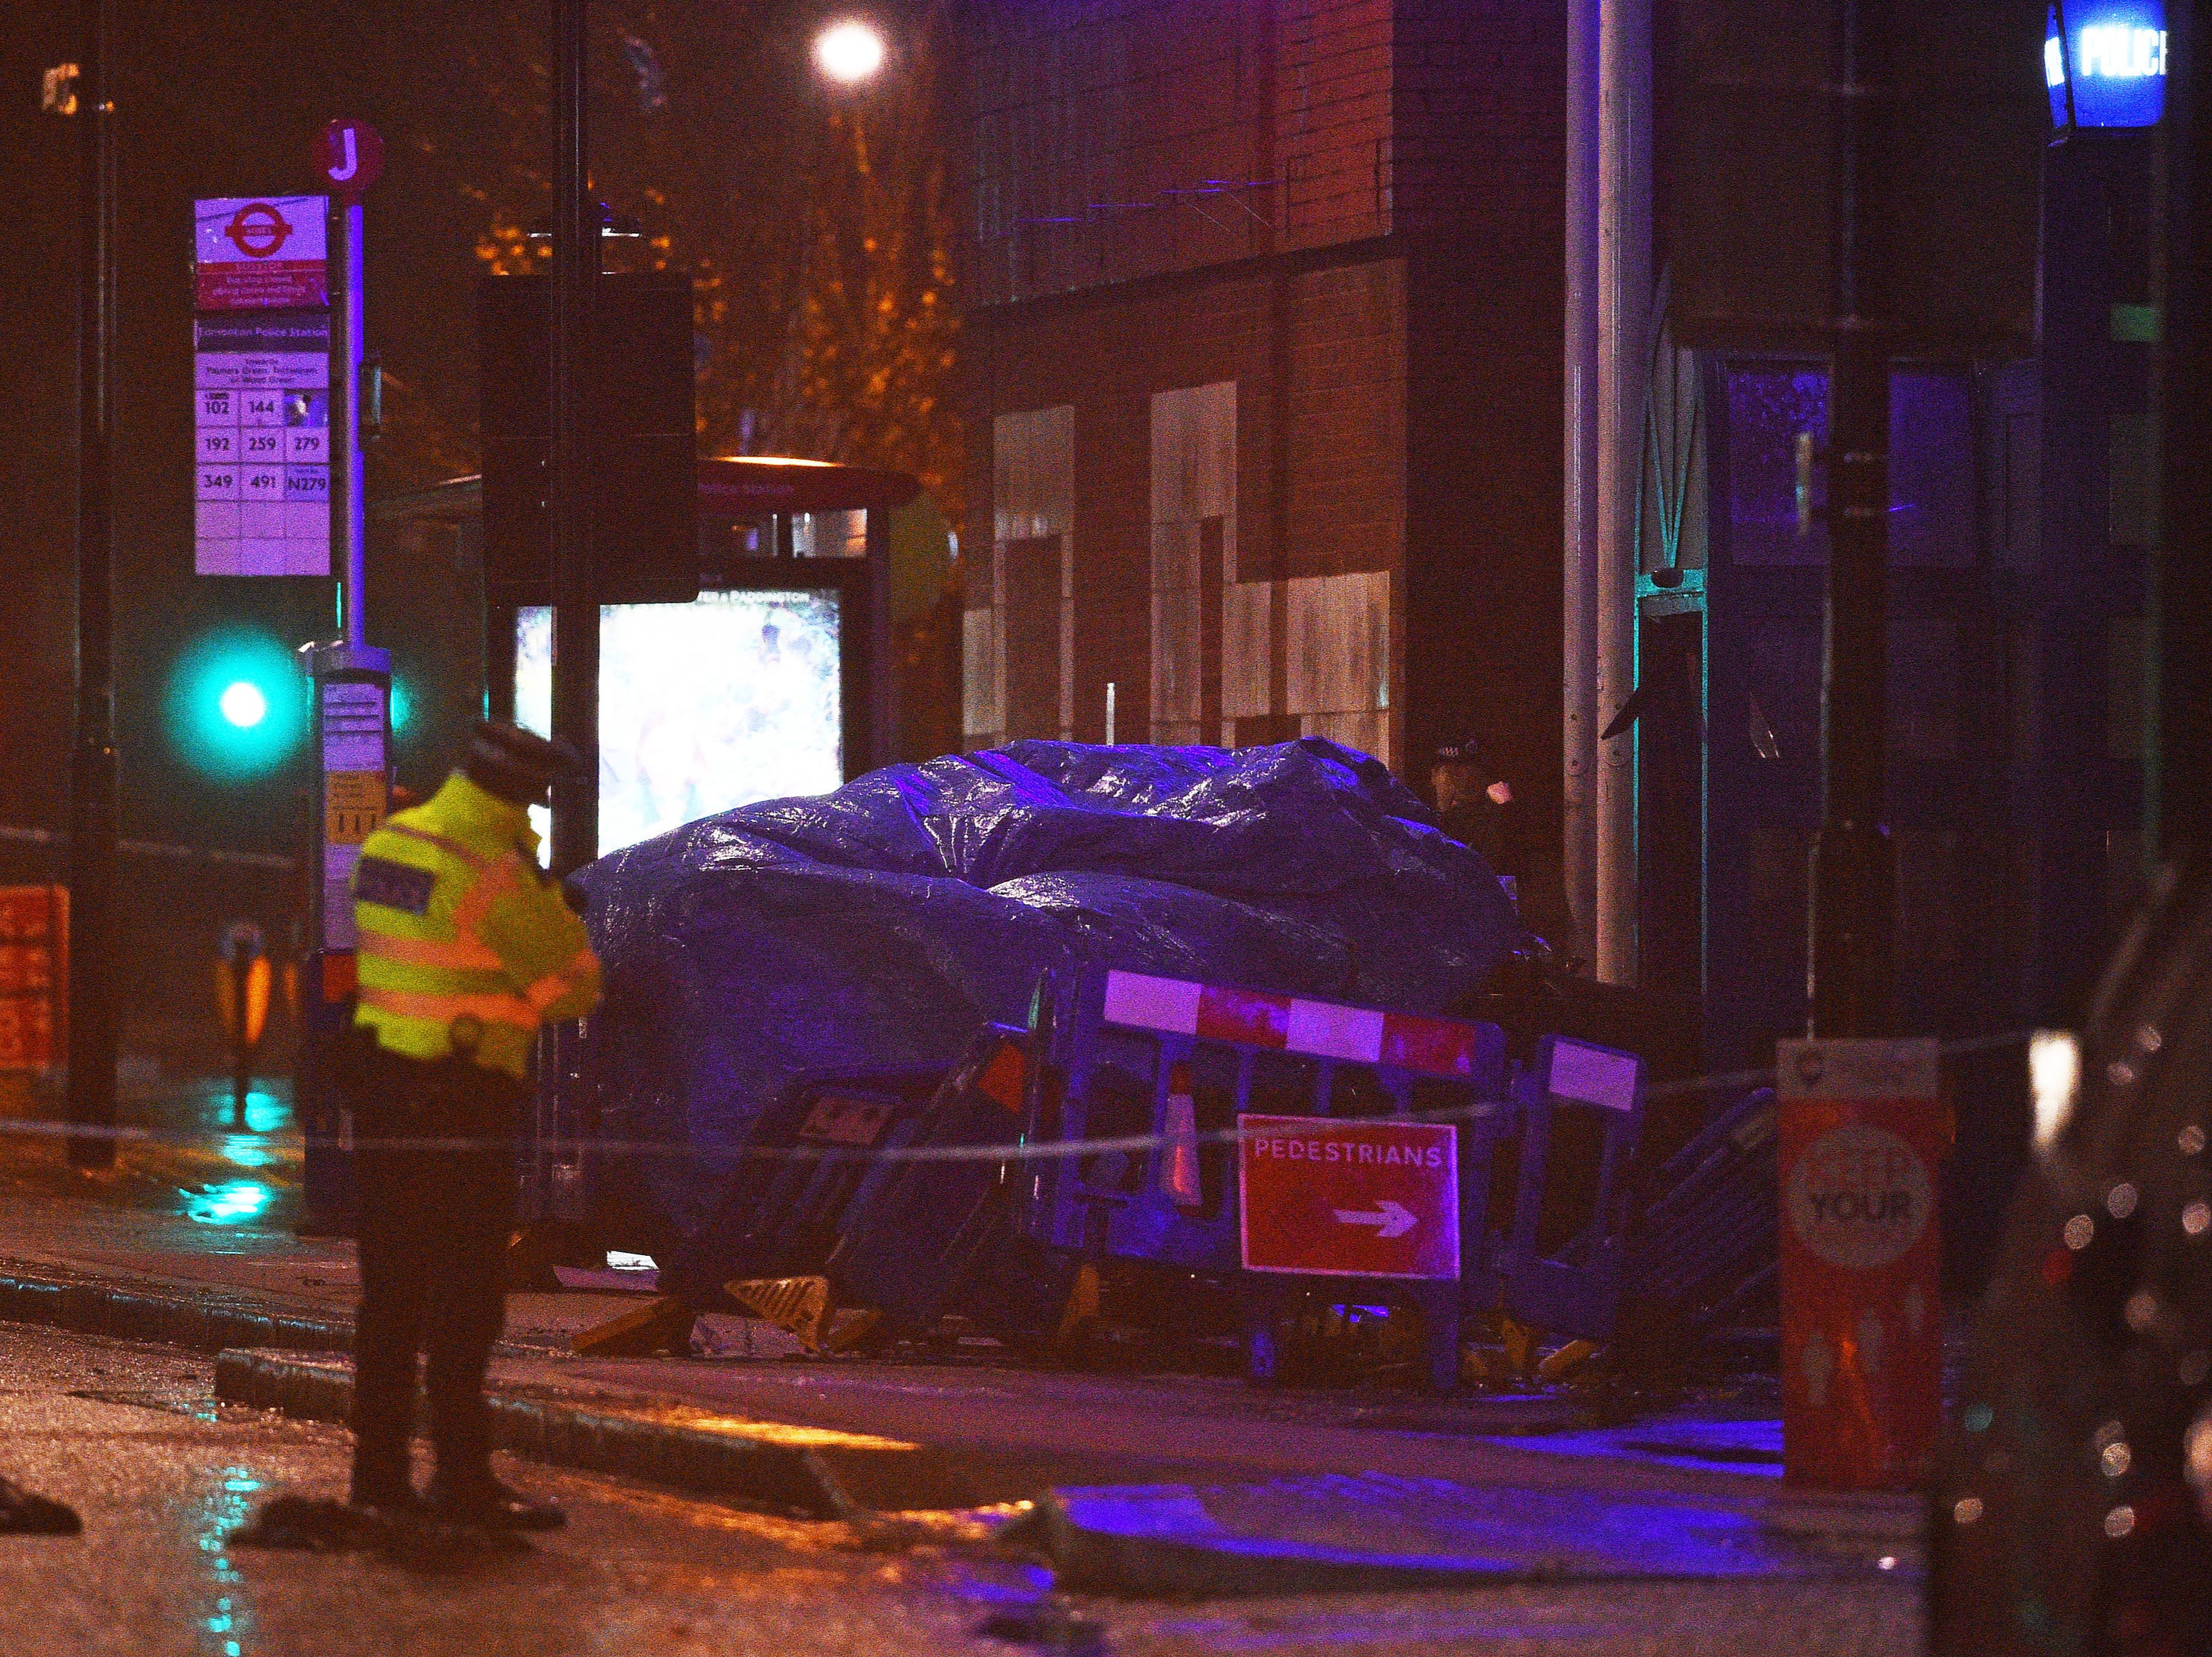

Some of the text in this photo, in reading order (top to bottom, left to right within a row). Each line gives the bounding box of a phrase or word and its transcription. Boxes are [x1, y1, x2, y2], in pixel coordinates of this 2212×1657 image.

[328, 128, 357, 181] J
[289, 326, 329, 337] Station
[205, 400, 274, 415] 102 144
[205, 437, 320, 451] 192 259 279
[205, 475, 327, 491] 349 491 N279
[1254, 1138, 1443, 1167] PEDESTRIANS
[1808, 1190, 1912, 1222] YOUR
